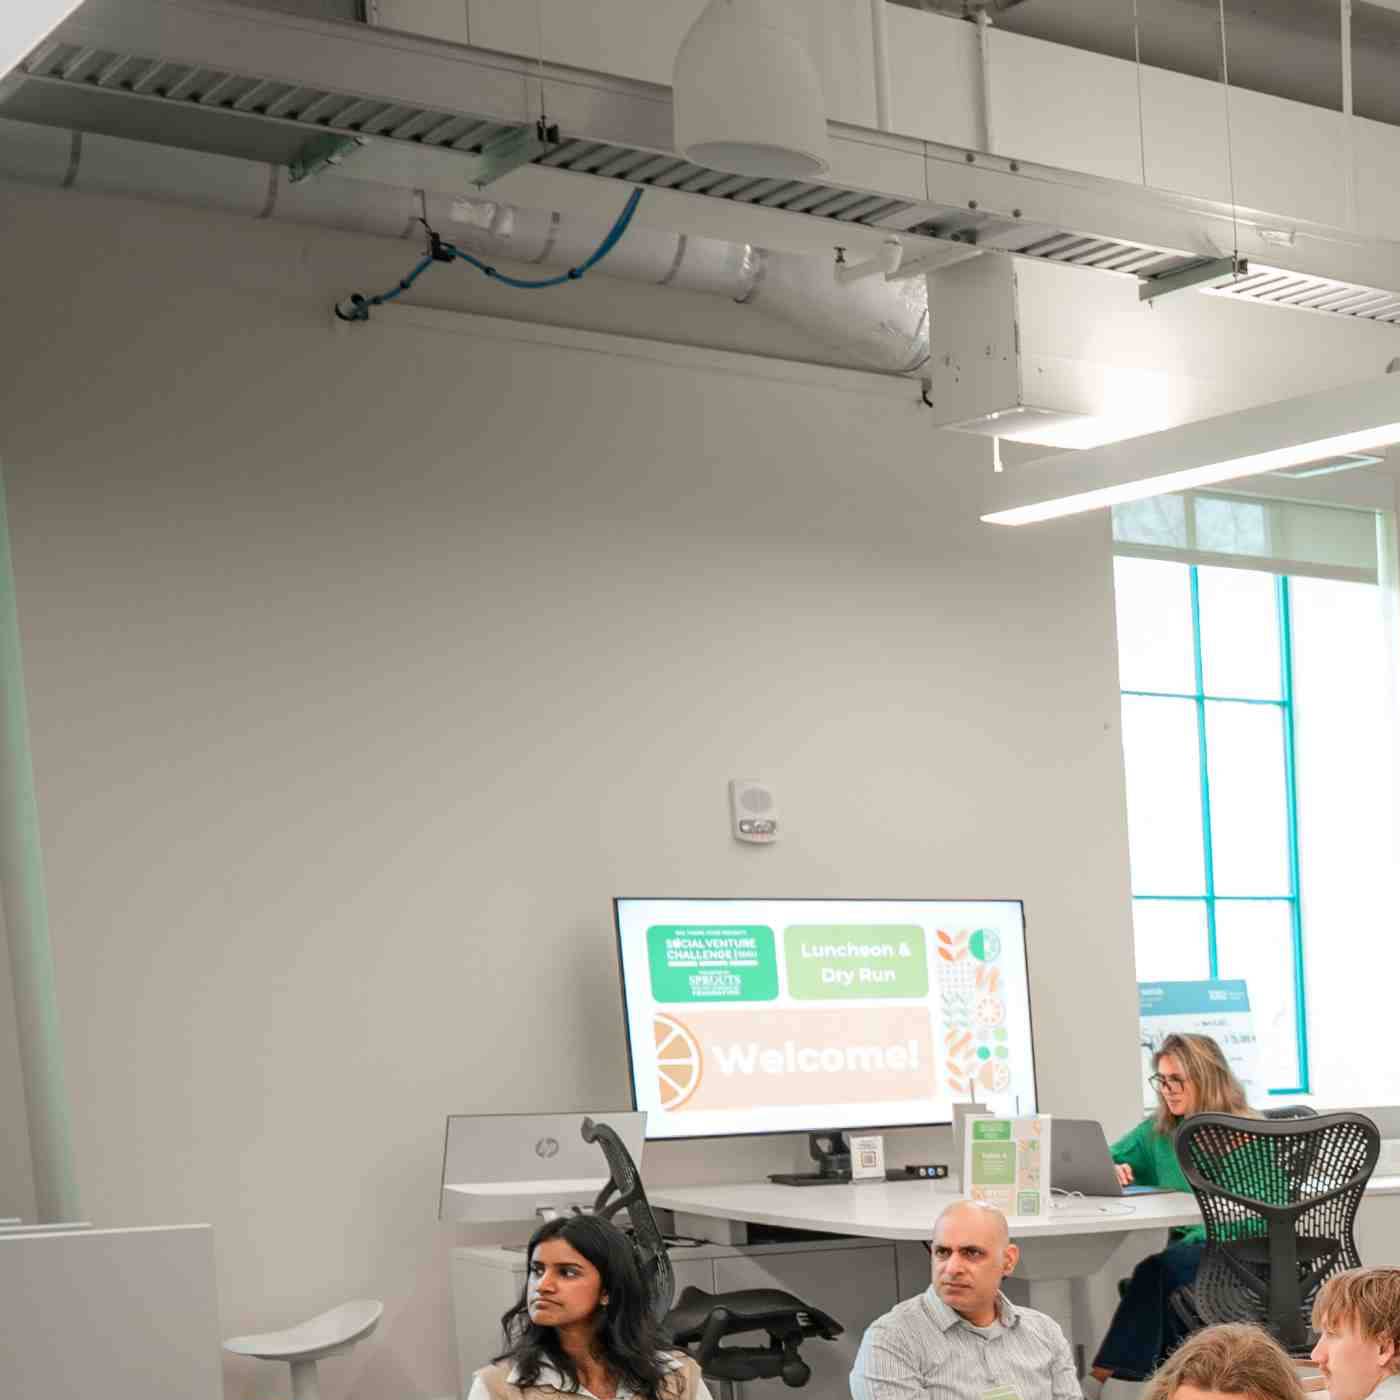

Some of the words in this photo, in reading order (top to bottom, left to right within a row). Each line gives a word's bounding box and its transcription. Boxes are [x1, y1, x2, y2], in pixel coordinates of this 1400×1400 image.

[801, 942, 893, 959] Luncheon
[896, 942, 911, 957] &
[822, 967, 855, 985] Dry
[859, 967, 896, 983] Run
[712, 1040, 921, 1075] Welcome!
